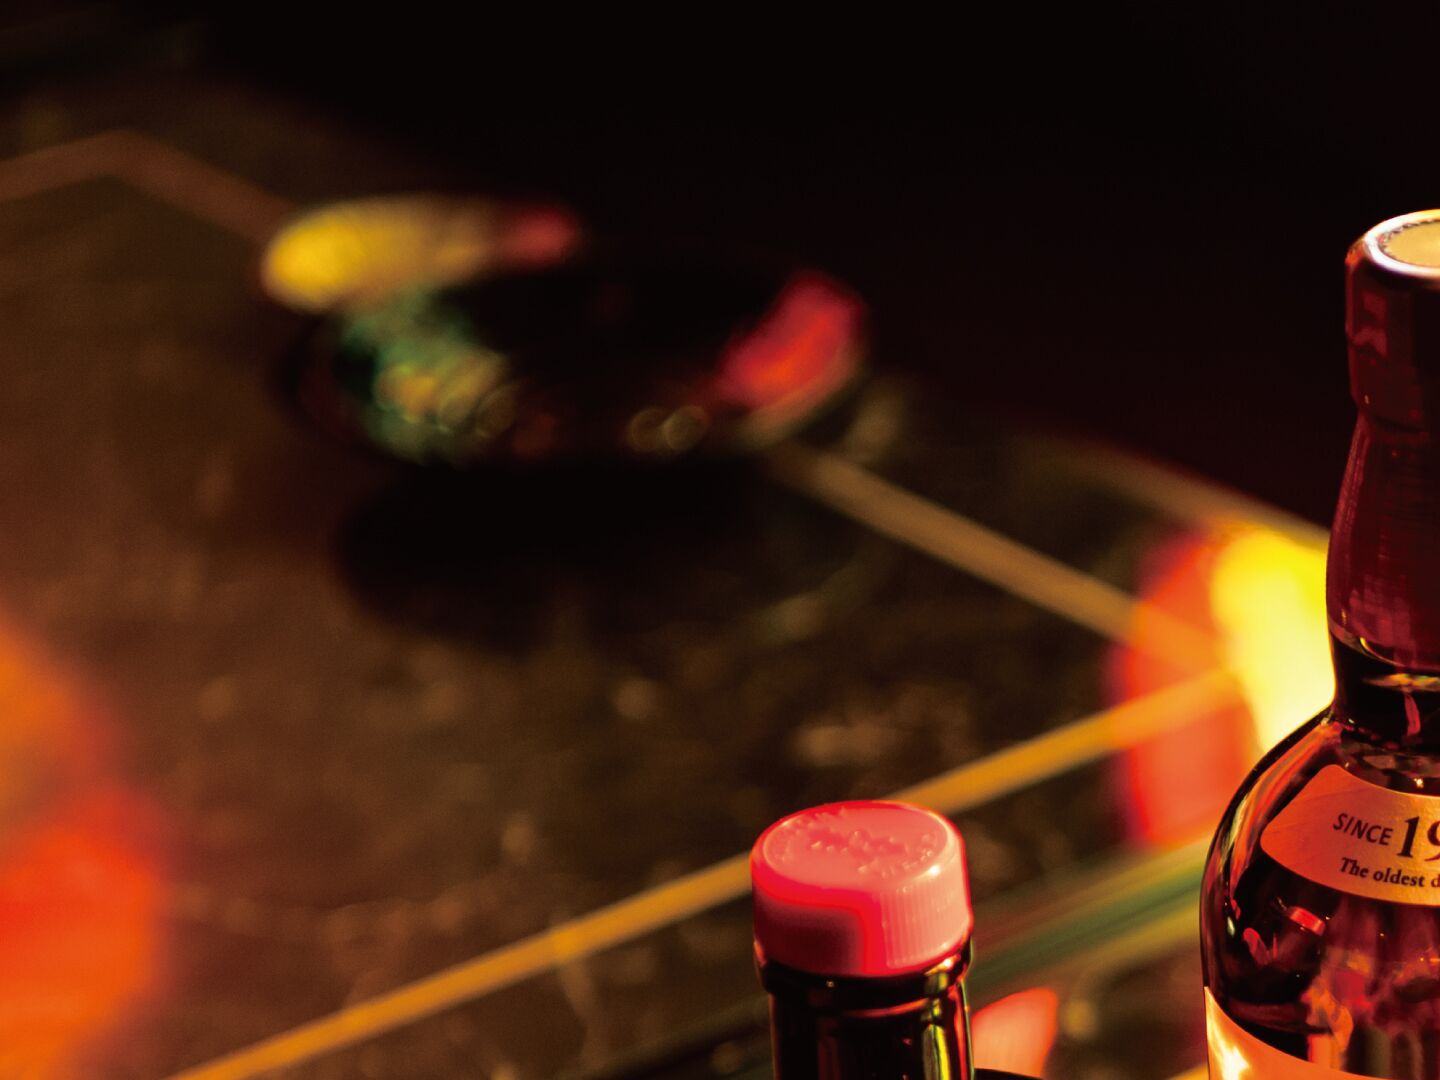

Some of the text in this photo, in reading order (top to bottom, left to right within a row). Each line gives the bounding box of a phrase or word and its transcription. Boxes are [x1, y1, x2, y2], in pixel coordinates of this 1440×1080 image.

[1332, 812, 1394, 847] SINCE
[1339, 857, 1369, 879] The
[1373, 865, 1426, 888] oldest
